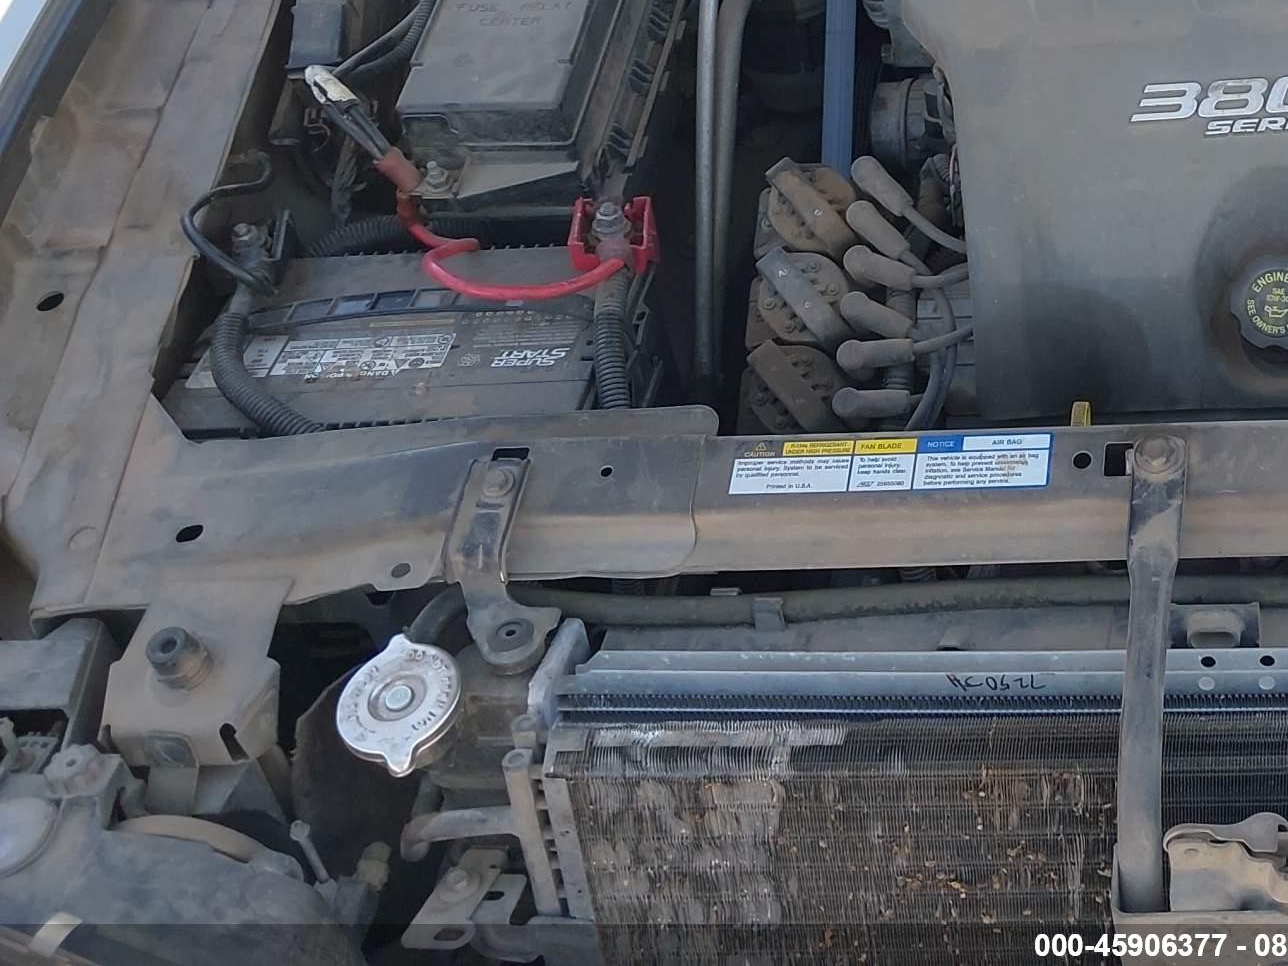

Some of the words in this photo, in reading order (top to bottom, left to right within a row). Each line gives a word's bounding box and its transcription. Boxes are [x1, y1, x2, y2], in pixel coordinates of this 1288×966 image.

[456, 3, 497, 12] FUSE
[479, 16, 542, 27] CENTER
[1272, 287, 1286, 295] SAE
[1247, 299, 1257, 317] SEE
[1252, 315, 1286, 335] OWNER'S
[494, 347, 571, 360] START
[490, 357, 556, 368] SUPER
[877, 442, 903, 450] BLADE
[927, 440, 956, 448] NOTICE
